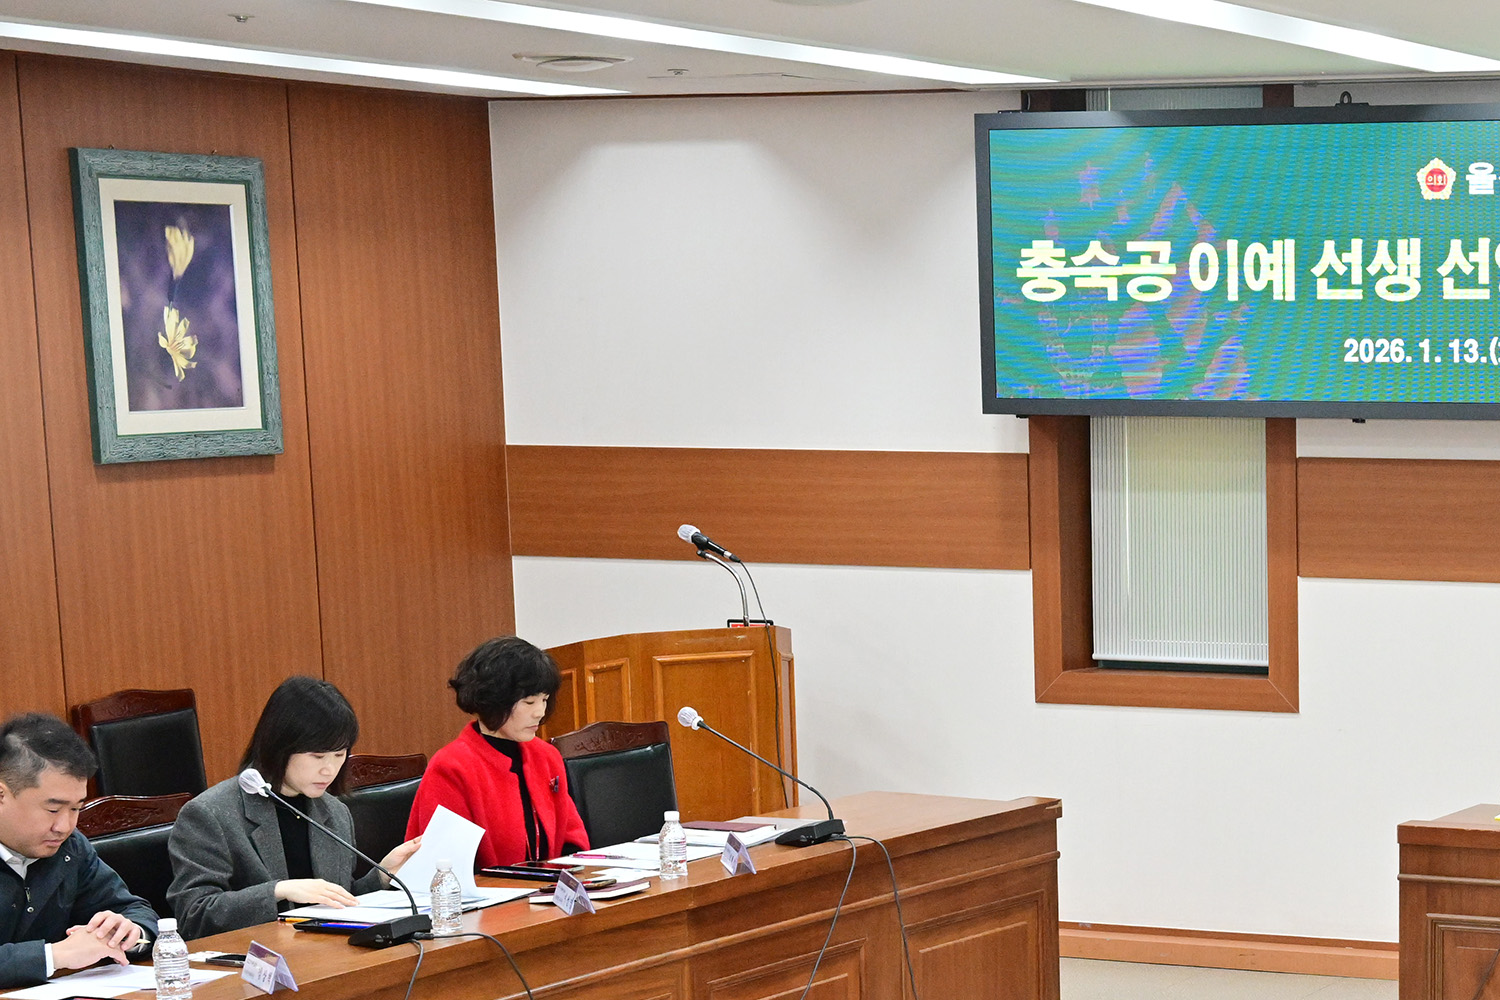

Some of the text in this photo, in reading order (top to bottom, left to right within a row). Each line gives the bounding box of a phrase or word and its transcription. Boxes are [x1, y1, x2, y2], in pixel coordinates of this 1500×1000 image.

[1426, 173, 1447, 186] 의회
[1016, 239, 1177, 302] 충숙공
[1188, 238, 1296, 302] 이예
[1310, 237, 1422, 302] 선생
[1343, 338, 1412, 364] 2026.
[1418, 338, 1442, 363] 1.
